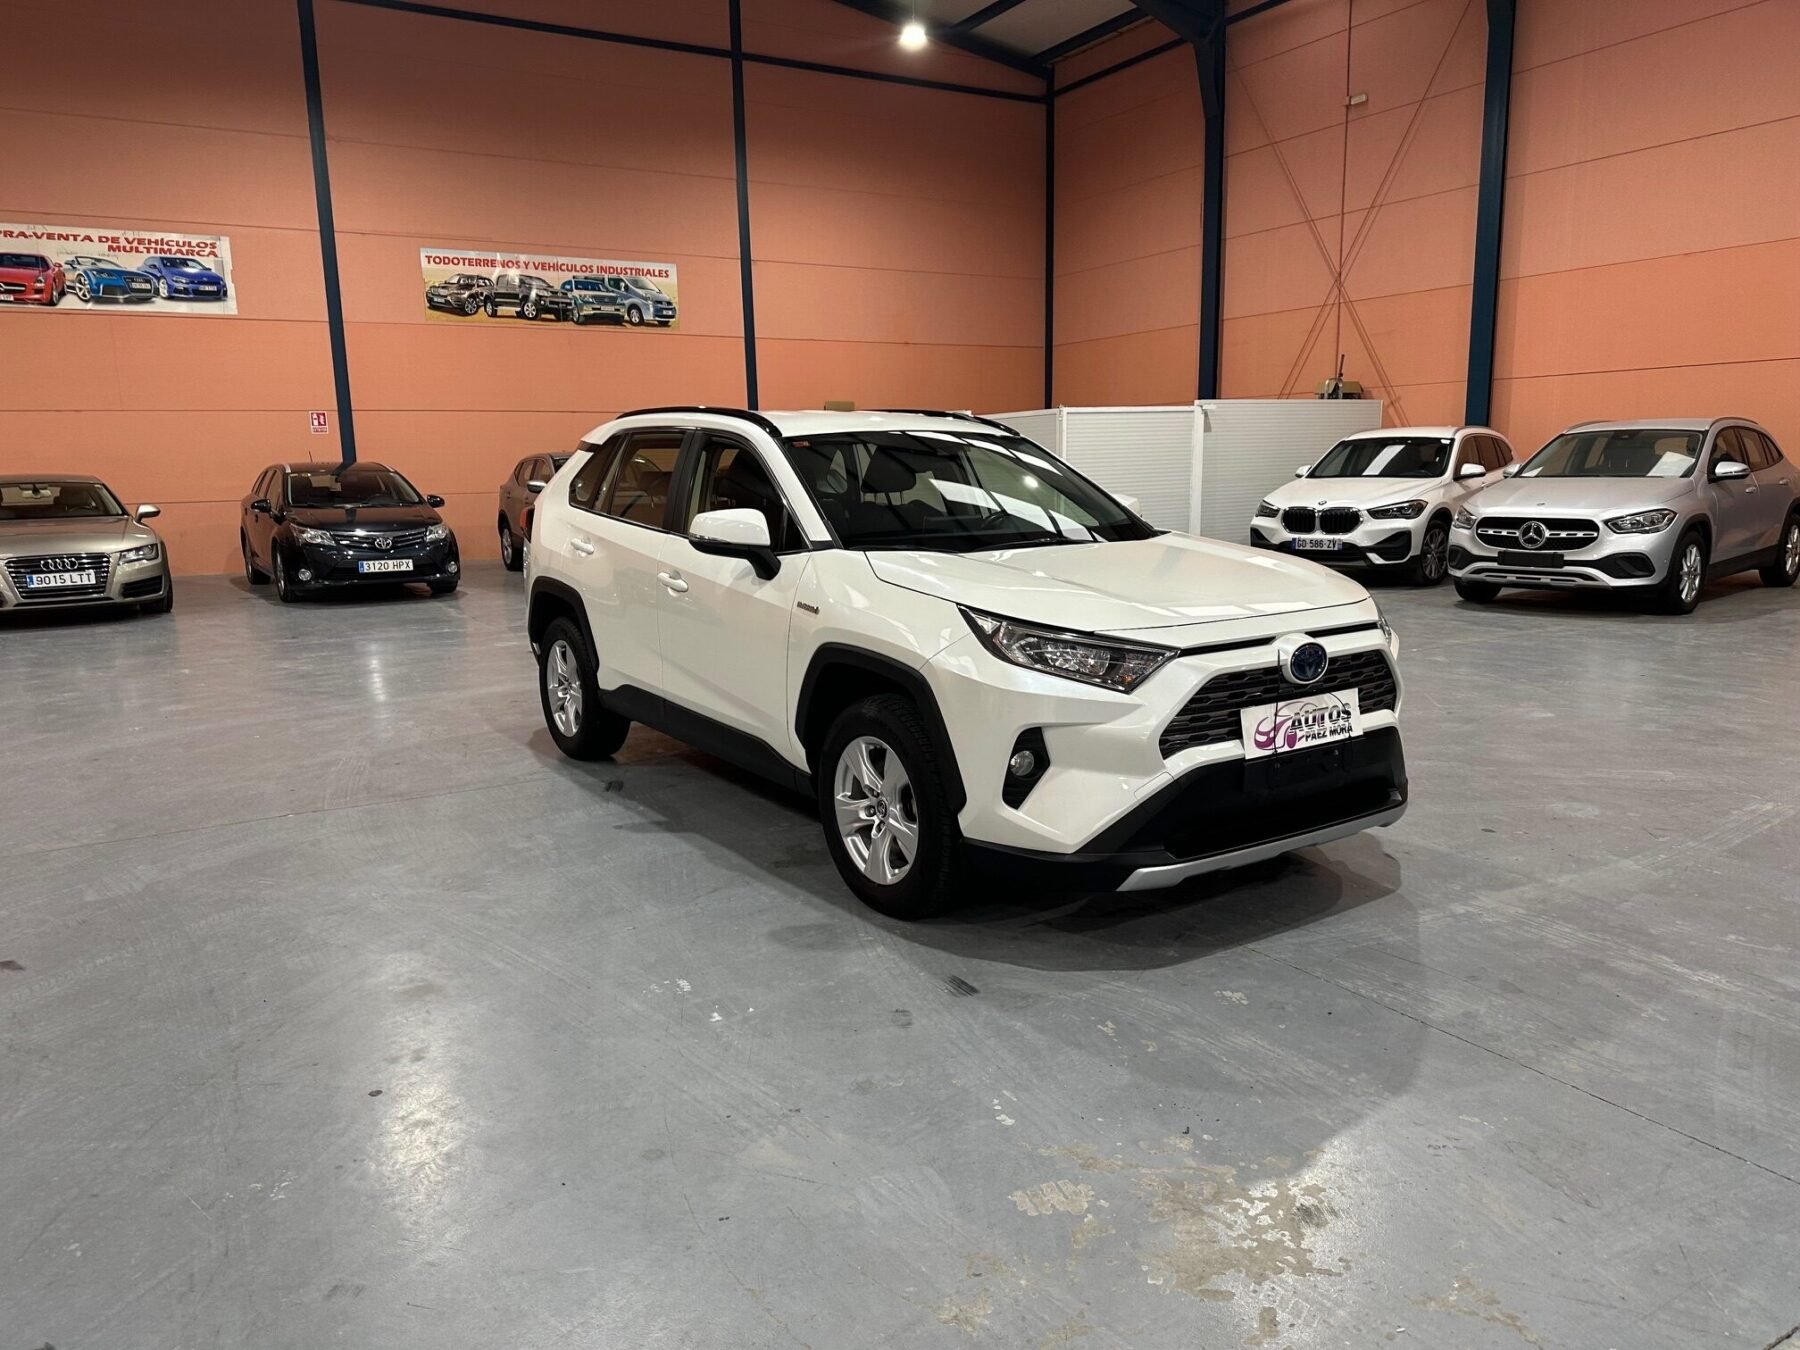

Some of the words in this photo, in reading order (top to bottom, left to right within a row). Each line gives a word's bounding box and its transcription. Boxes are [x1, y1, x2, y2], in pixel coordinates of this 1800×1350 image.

[0, 230, 94, 243] RA-VENTA
[98, 236, 121, 244] DE
[124, 237, 217, 250] VEHÍCULOS
[107, 245, 219, 258] MULTIMARCA
[425, 255, 520, 269] TODOTERRENOS
[523, 261, 531, 270] Y
[533, 261, 594, 274] VEHÍCULOS
[597, 265, 670, 279] INDUSTRIALES
[365, 561, 390, 571] 3120
[392, 560, 411, 570] HPX
[36, 574, 67, 586] 9015
[69, 573, 92, 585] LTT
[1290, 702, 1352, 731] AUTOS
